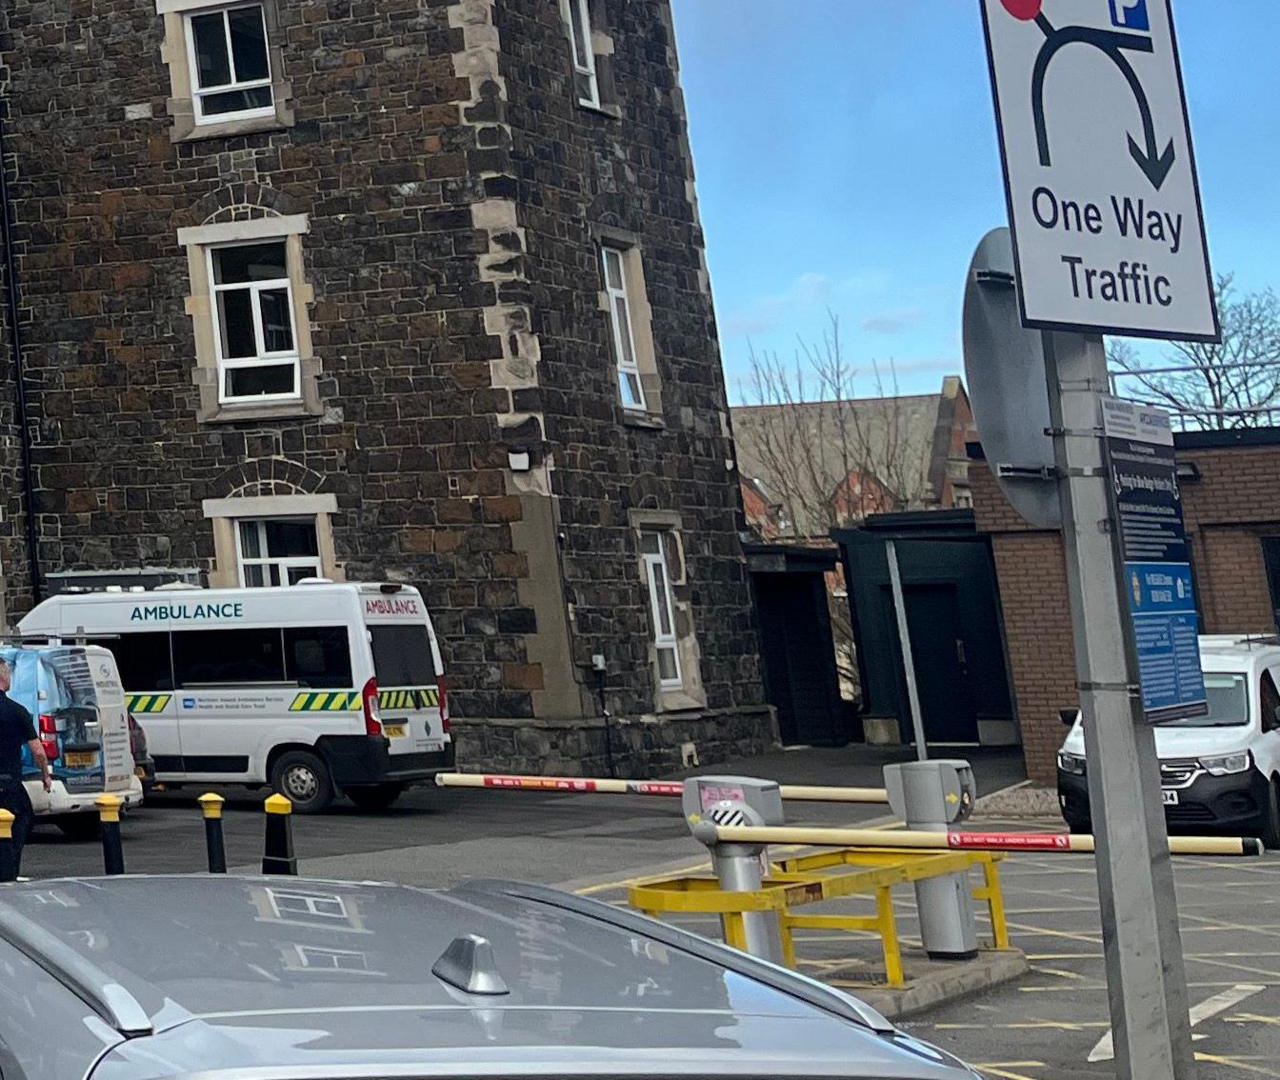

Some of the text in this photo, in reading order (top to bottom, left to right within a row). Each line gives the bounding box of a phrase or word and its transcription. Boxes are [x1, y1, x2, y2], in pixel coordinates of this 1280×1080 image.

[1032, 186, 1182, 254] One Way
[1061, 255, 1173, 307] Traffic
[130, 602, 244, 621] AMBULANCE
[365, 599, 419, 615] AMBULANCE
